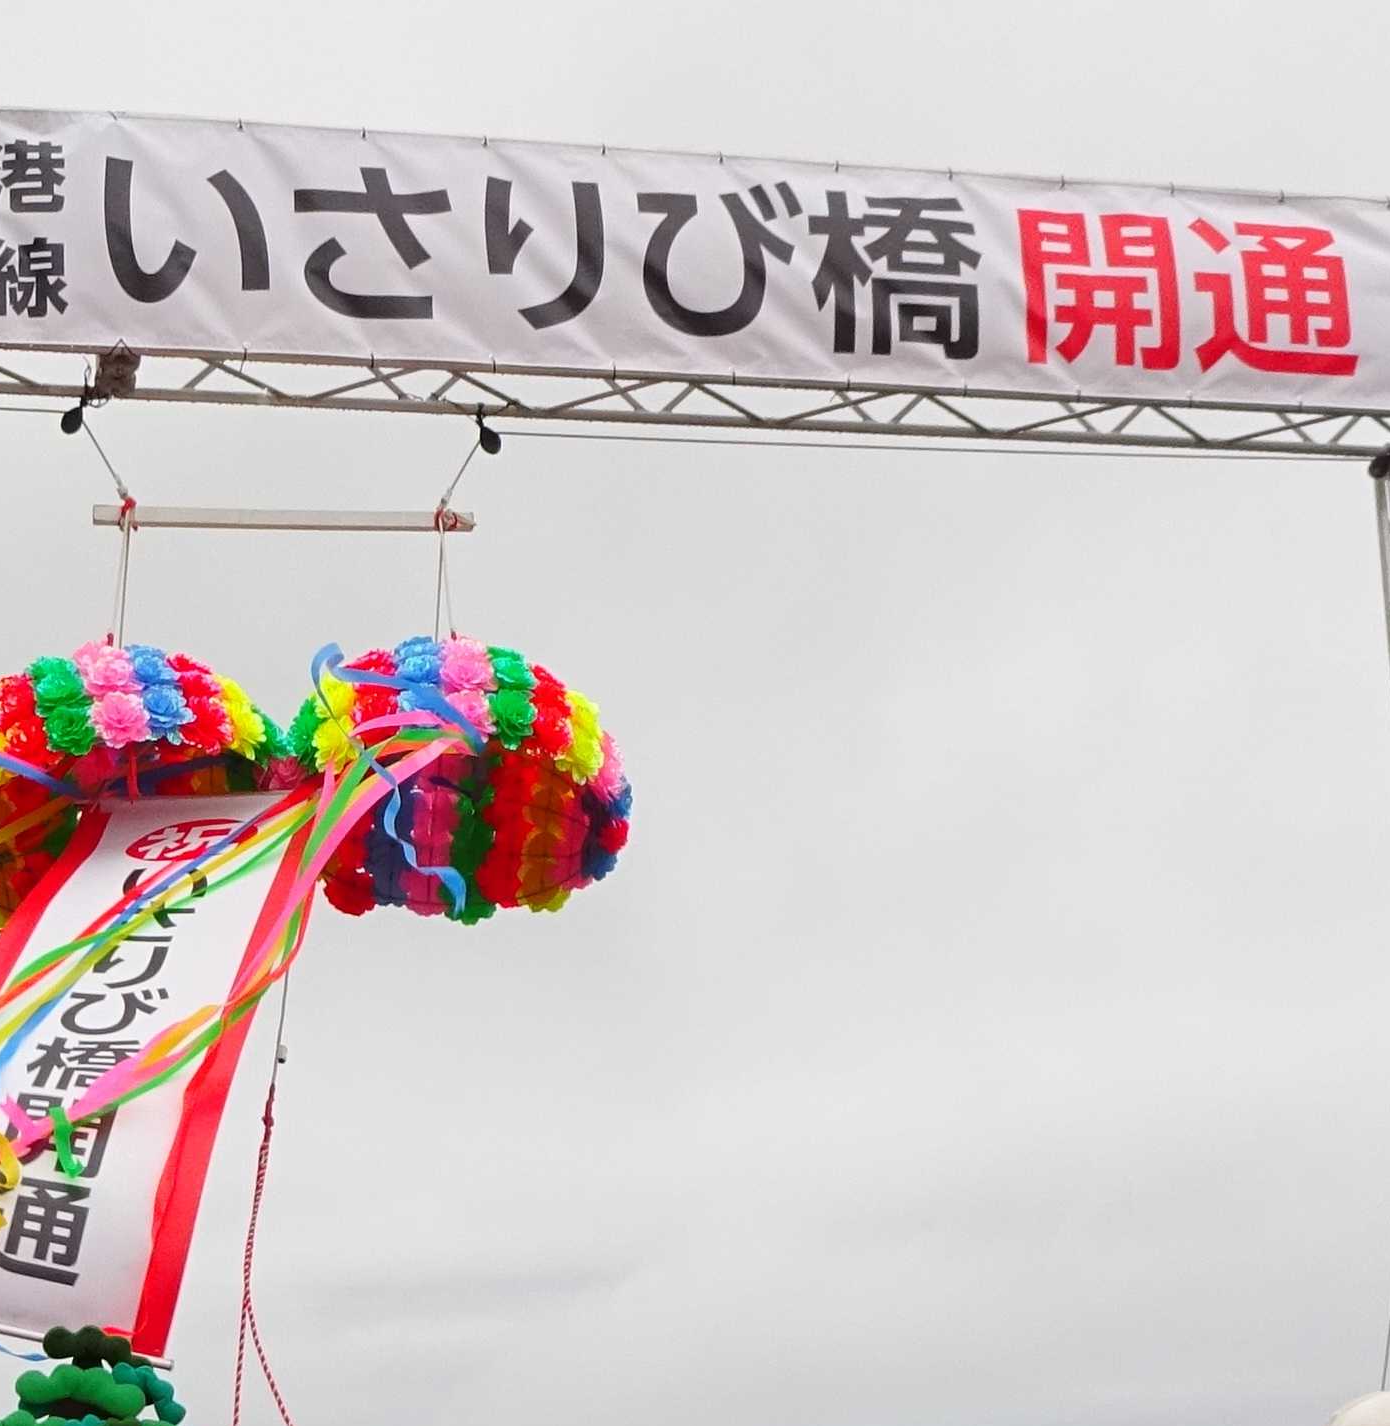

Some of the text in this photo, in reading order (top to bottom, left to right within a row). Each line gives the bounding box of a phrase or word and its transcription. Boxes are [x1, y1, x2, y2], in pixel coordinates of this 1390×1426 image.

[103, 155, 1360, 378] いさりび橋 開通
